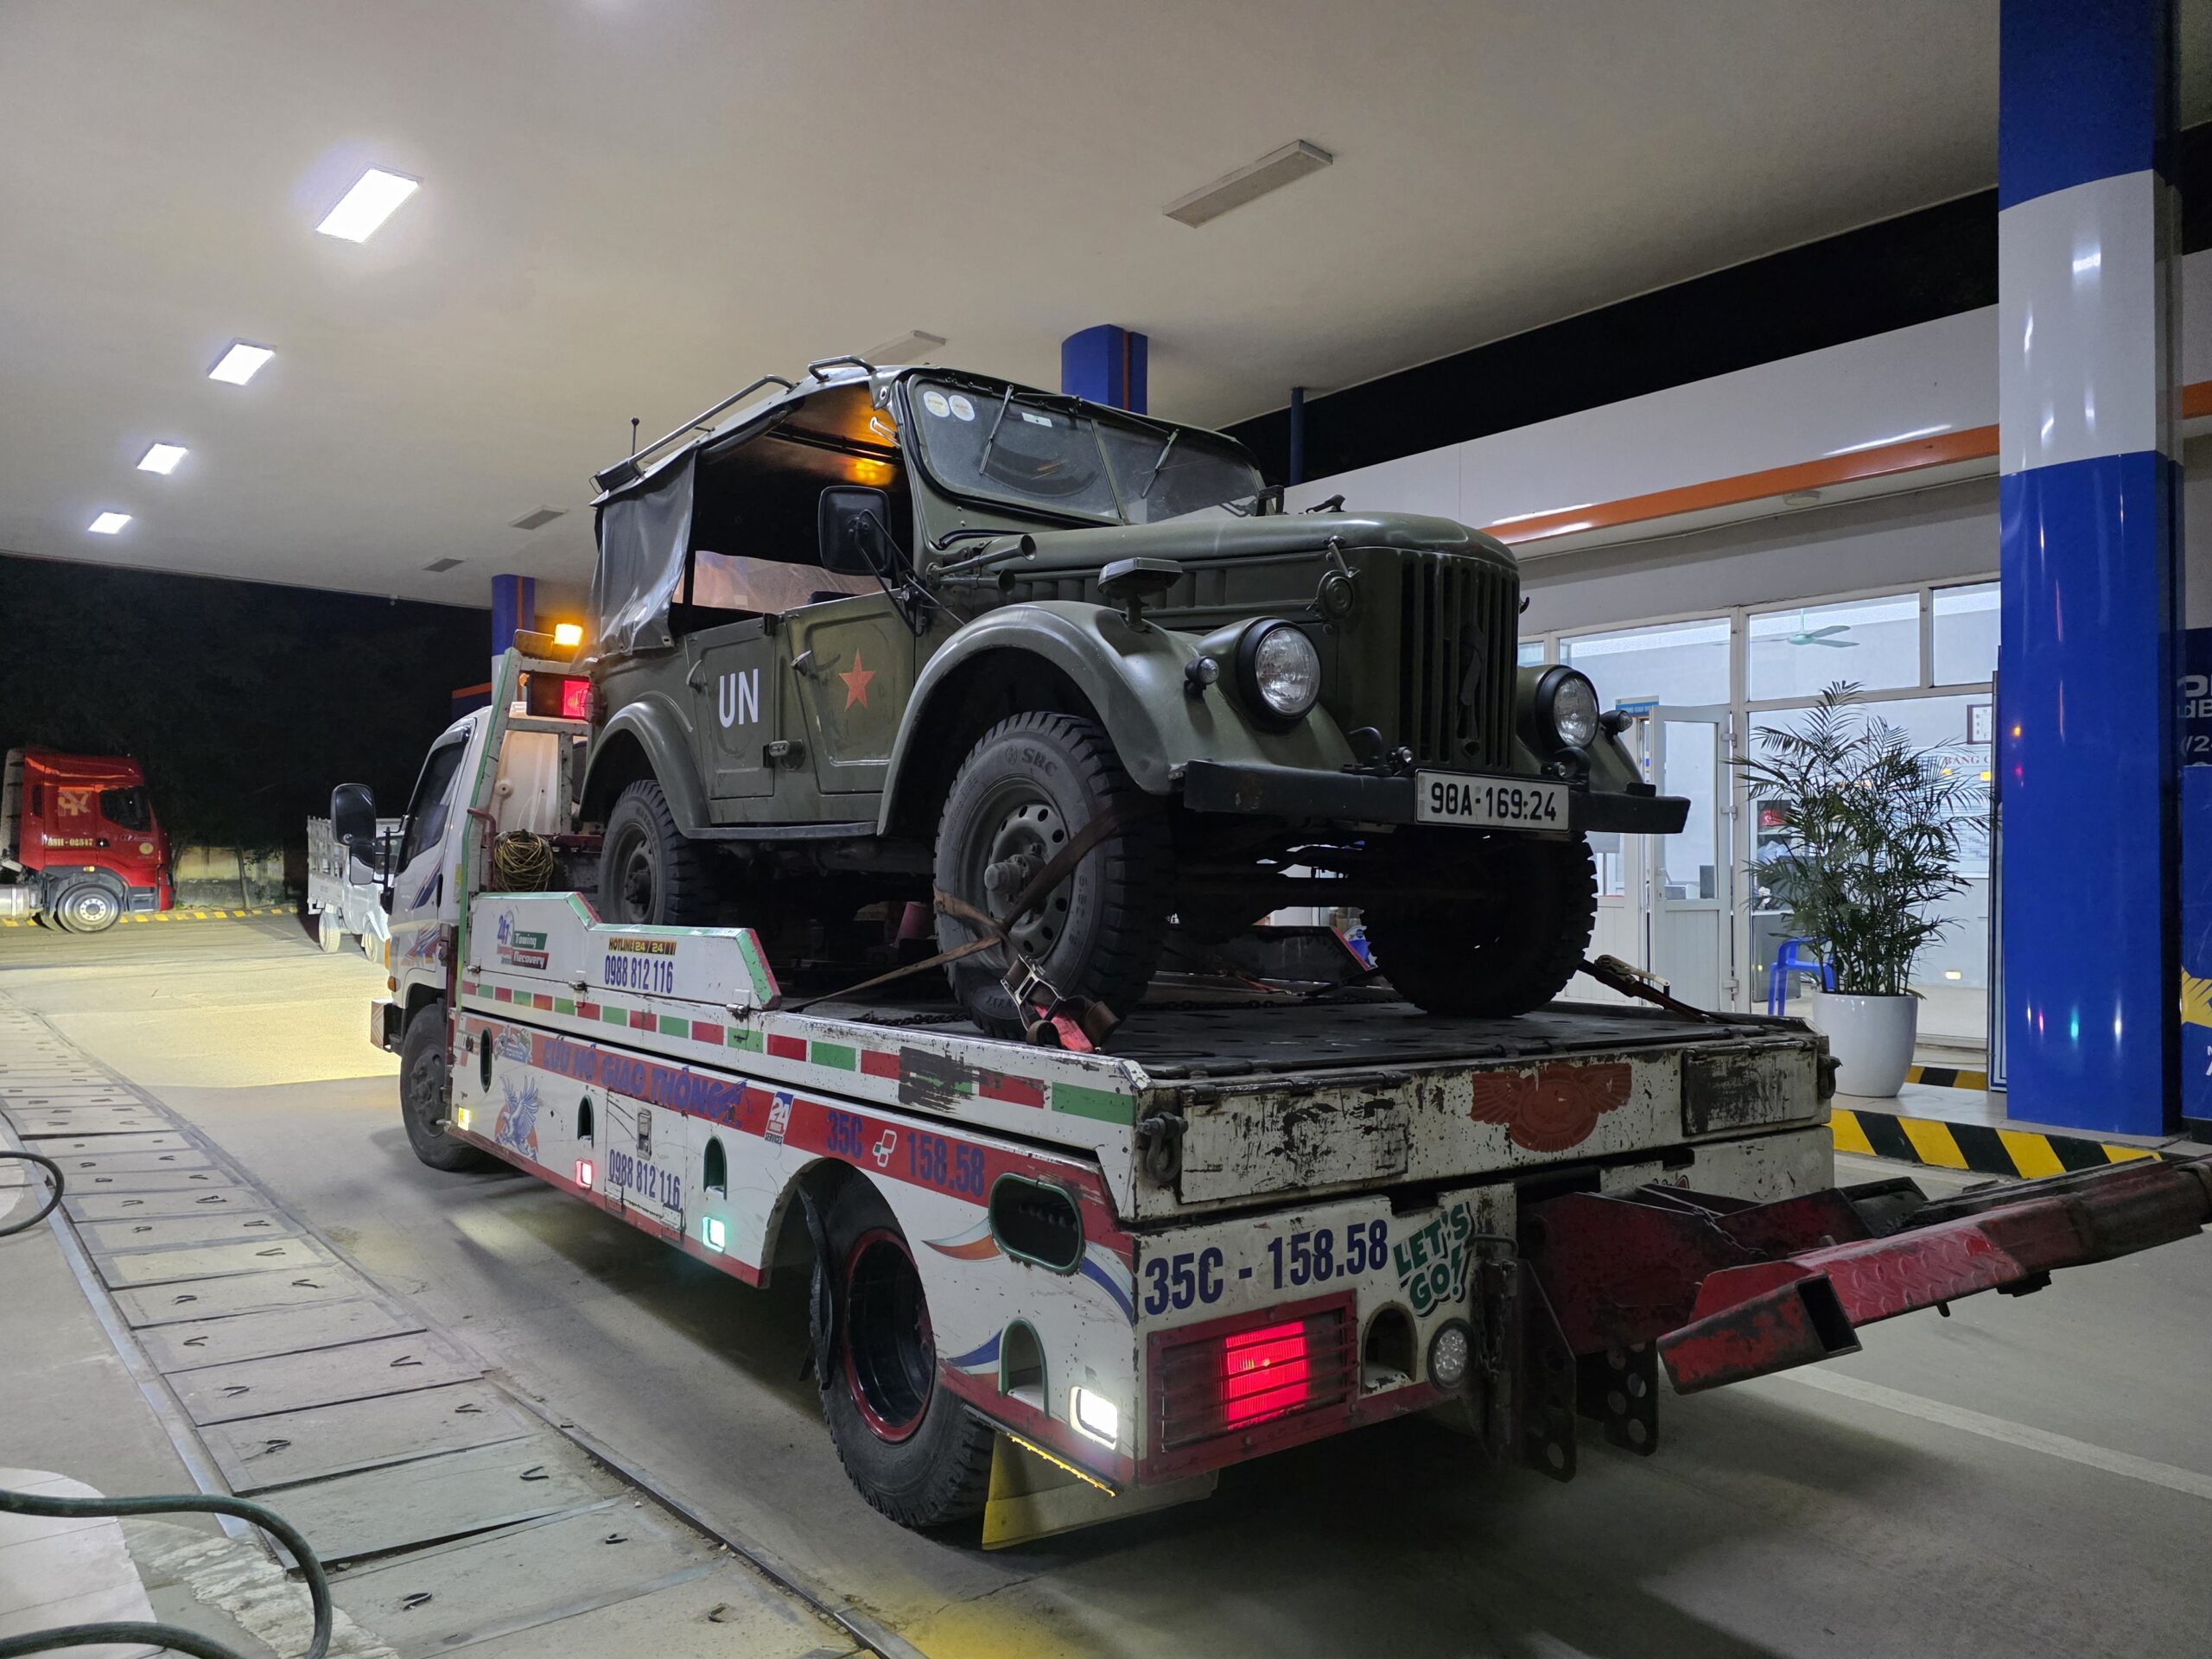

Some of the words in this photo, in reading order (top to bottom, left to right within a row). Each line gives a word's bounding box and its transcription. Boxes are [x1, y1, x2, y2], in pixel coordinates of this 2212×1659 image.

[719, 669, 759, 728] UN
[513, 950, 545, 969] Recovery
[514, 932, 537, 949] Towing
[605, 955, 628, 987] 0988
[631, 957, 650, 990] 812
[654, 959, 674, 994] 116
[601, 1054, 645, 1096] GIAO
[770, 1096, 790, 1123] 24
[608, 1148, 633, 1189] 0988
[636, 1160, 657, 1199] 812
[659, 1170, 681, 1211] 116
[826, 1109, 863, 1160] 35C
[907, 1131, 986, 1198] 158.58
[1144, 1247, 1224, 1316] 35C
[1267, 1218, 1389, 1290] 158.58
[1393, 1203, 1470, 1279] LET'S
[1409, 1244, 1463, 1310] GO!
